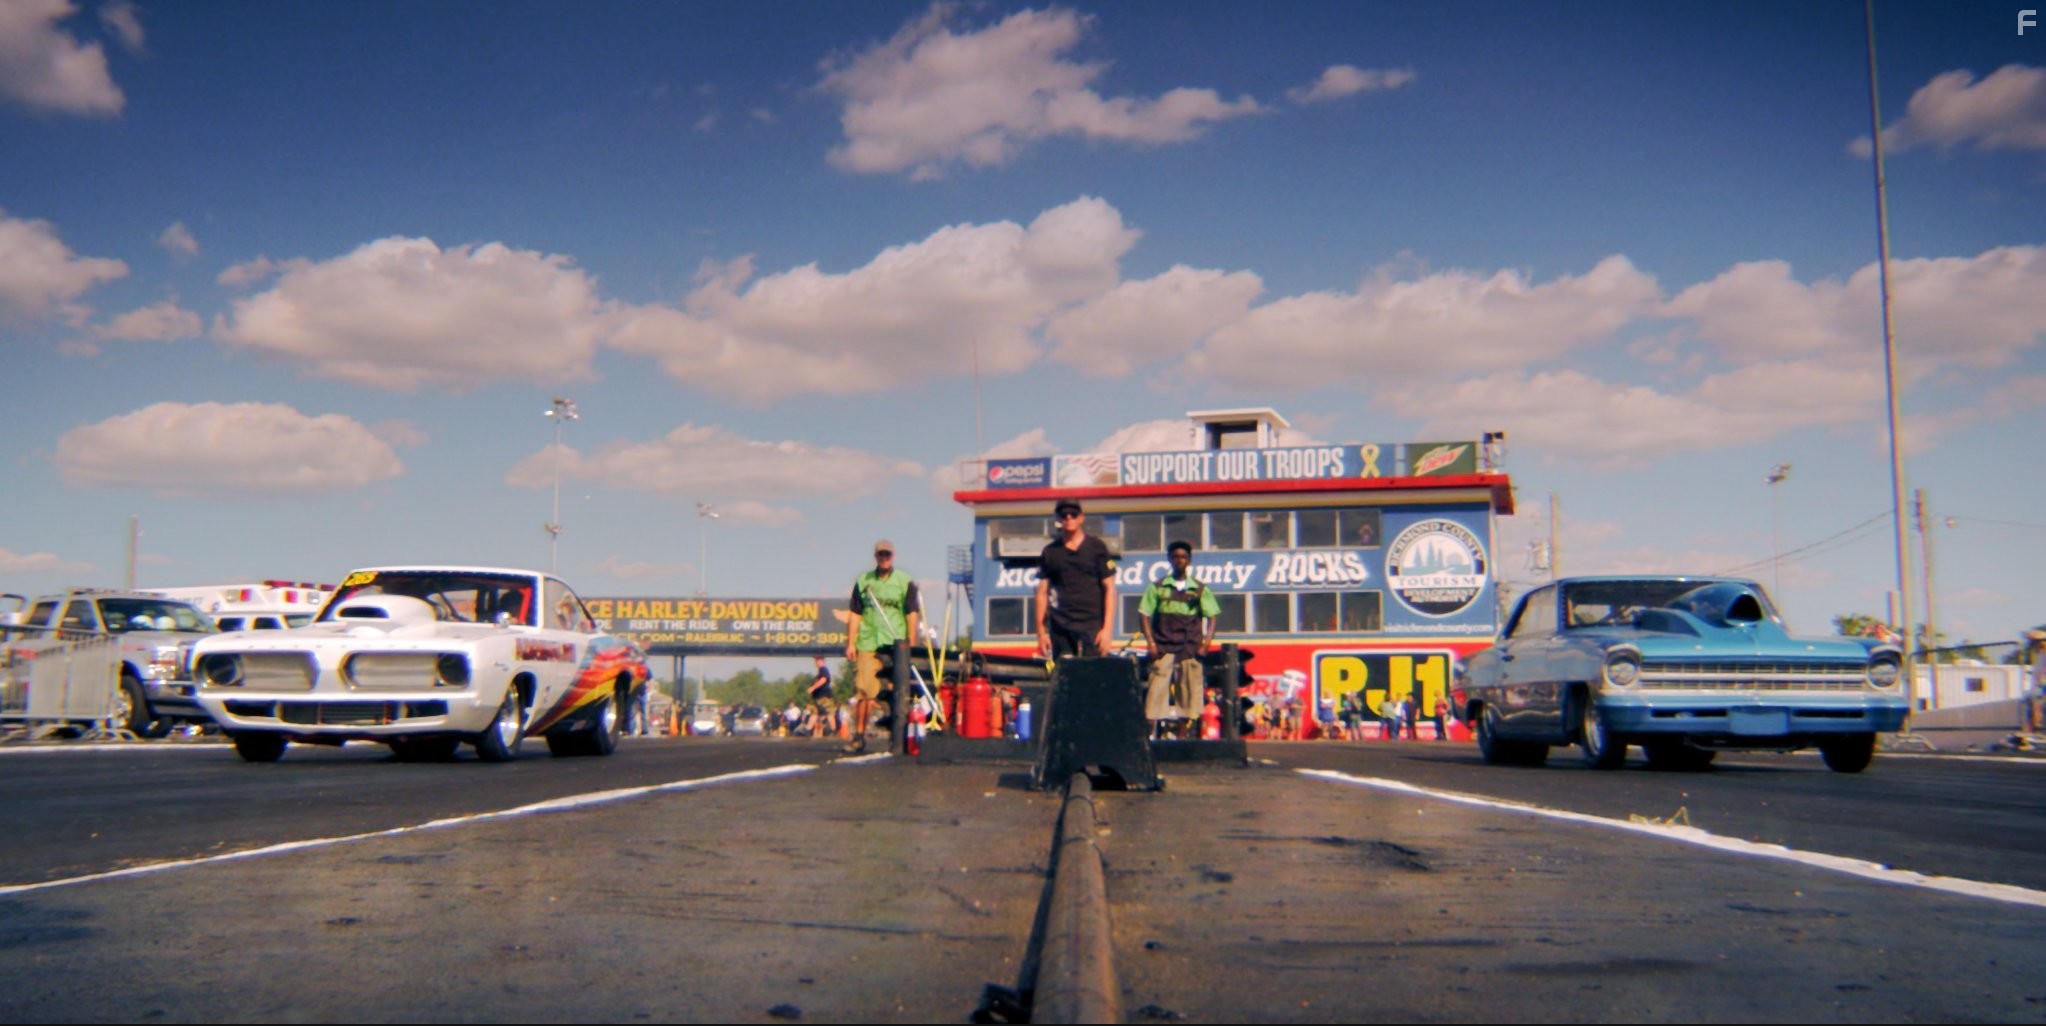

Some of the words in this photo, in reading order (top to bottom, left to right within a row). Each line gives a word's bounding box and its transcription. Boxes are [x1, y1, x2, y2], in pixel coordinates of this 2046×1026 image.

[1004, 463, 1044, 478] pepsi
[1125, 452, 1214, 485] SUPPORT
[1217, 450, 1259, 480] OUR
[1263, 447, 1345, 478] TROOPS
[1389, 522, 1441, 566] RICHMOND
[1442, 522, 1485, 560] COUNTY
[1148, 560, 1257, 590] Cunty
[1264, 551, 1368, 587] ROCKS
[1398, 577, 1476, 587] TOURISM
[616, 600, 819, 620] HARLEY-DAVIDSON
[629, 620, 659, 631] RENT
[662, 620, 686, 631] THE
[688, 620, 718, 631] RIDE
[732, 620, 760, 631] OWN
[763, 620, 785, 631] THE
[787, 620, 814, 632] RIDE
[1319, 655, 1446, 718] PJ1
